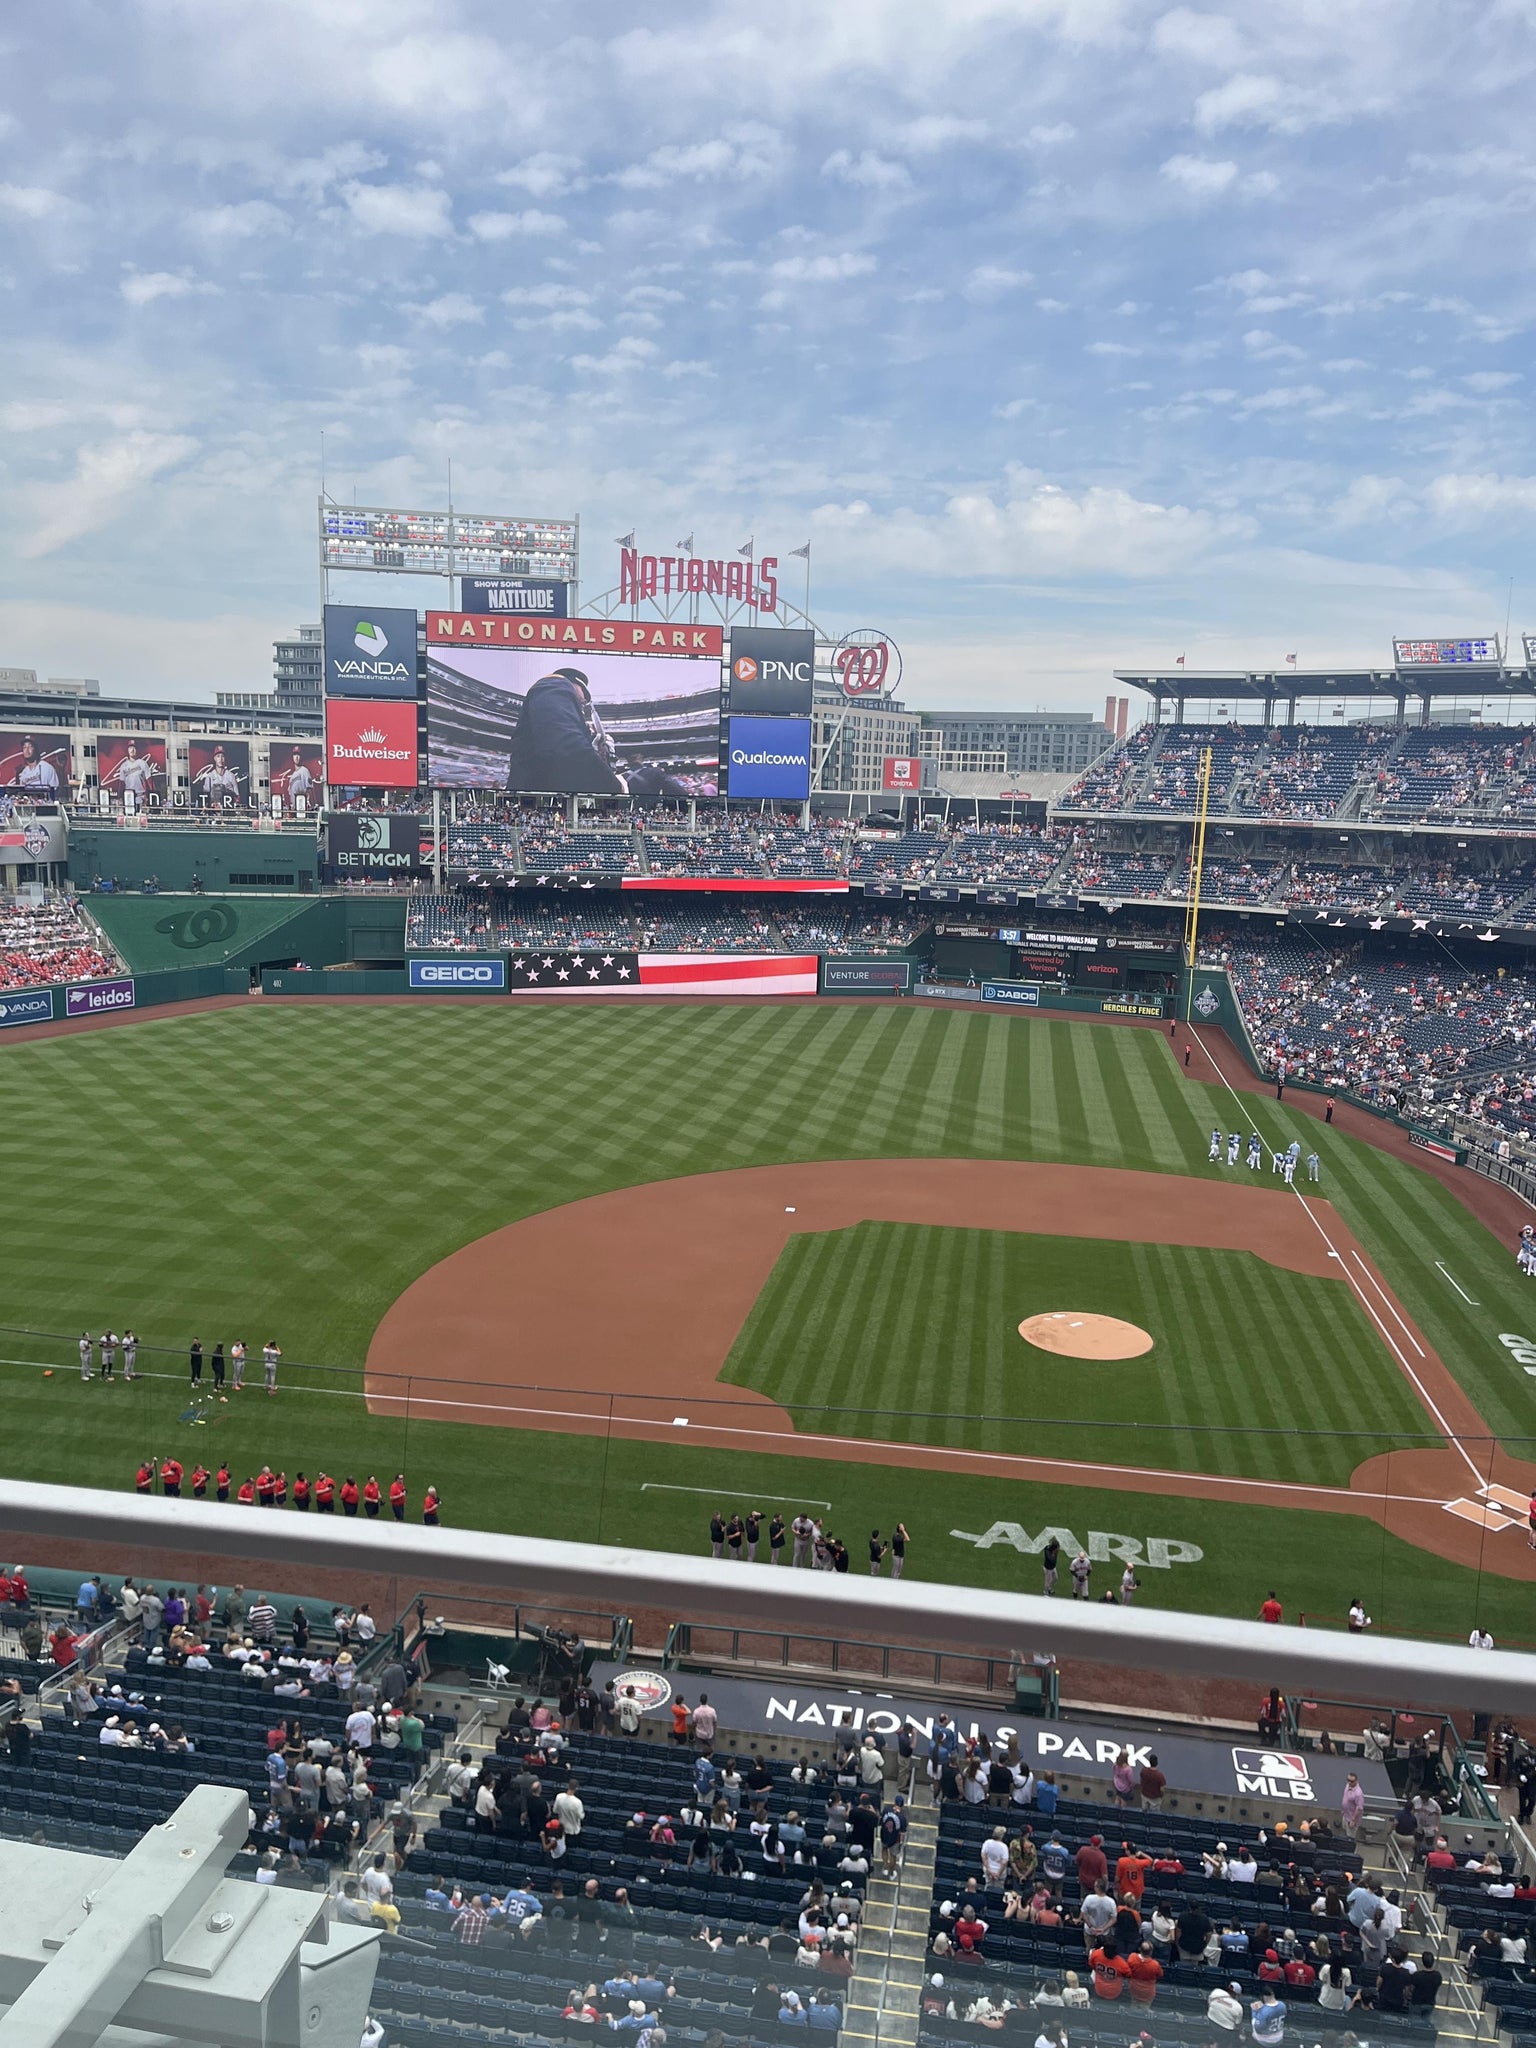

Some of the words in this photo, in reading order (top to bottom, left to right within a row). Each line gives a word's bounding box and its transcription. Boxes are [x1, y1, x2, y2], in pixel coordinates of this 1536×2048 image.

[474, 580, 498, 588] SHOW
[620, 547, 777, 613] NATIONALS
[488, 589, 554, 609] NATITUDE
[438, 618, 616, 644] NATIONALS
[632, 628, 707, 648] PARK
[334, 659, 409, 676] VANDA
[760, 660, 810, 681] PNC
[333, 744, 411, 760] Budweiser
[732, 749, 807, 766] Qualcomm
[338, 852, 411, 867] BETMGM
[1002, 930, 1017, 940] 3:57
[1025, 932, 1049, 941] WELCOME
[1056, 935, 1084, 944] NATIONALS
[1018, 948, 1051, 957] Nationals
[1023, 956, 1054, 964] powered
[420, 966, 493, 981] GEICO
[1030, 963, 1057, 972] Verizon
[1086, 964, 1119, 974] verizon
[830, 971, 869, 980] VENTURE
[89, 988, 132, 1008] leidos
[997, 990, 1036, 1001] DABOS
[7, 1000, 48, 1013] VANDA
[1103, 1004, 1137, 1013] HERCULES
[1138, 1007, 1160, 1015] FENCE
[950, 1521, 1204, 1569] AARP
[623, 1707, 633, 1717] 51
[1038, 1732, 1152, 1768] PARK
[1236, 1773, 1316, 1801] MLB
[508, 1899, 527, 1917] 26
